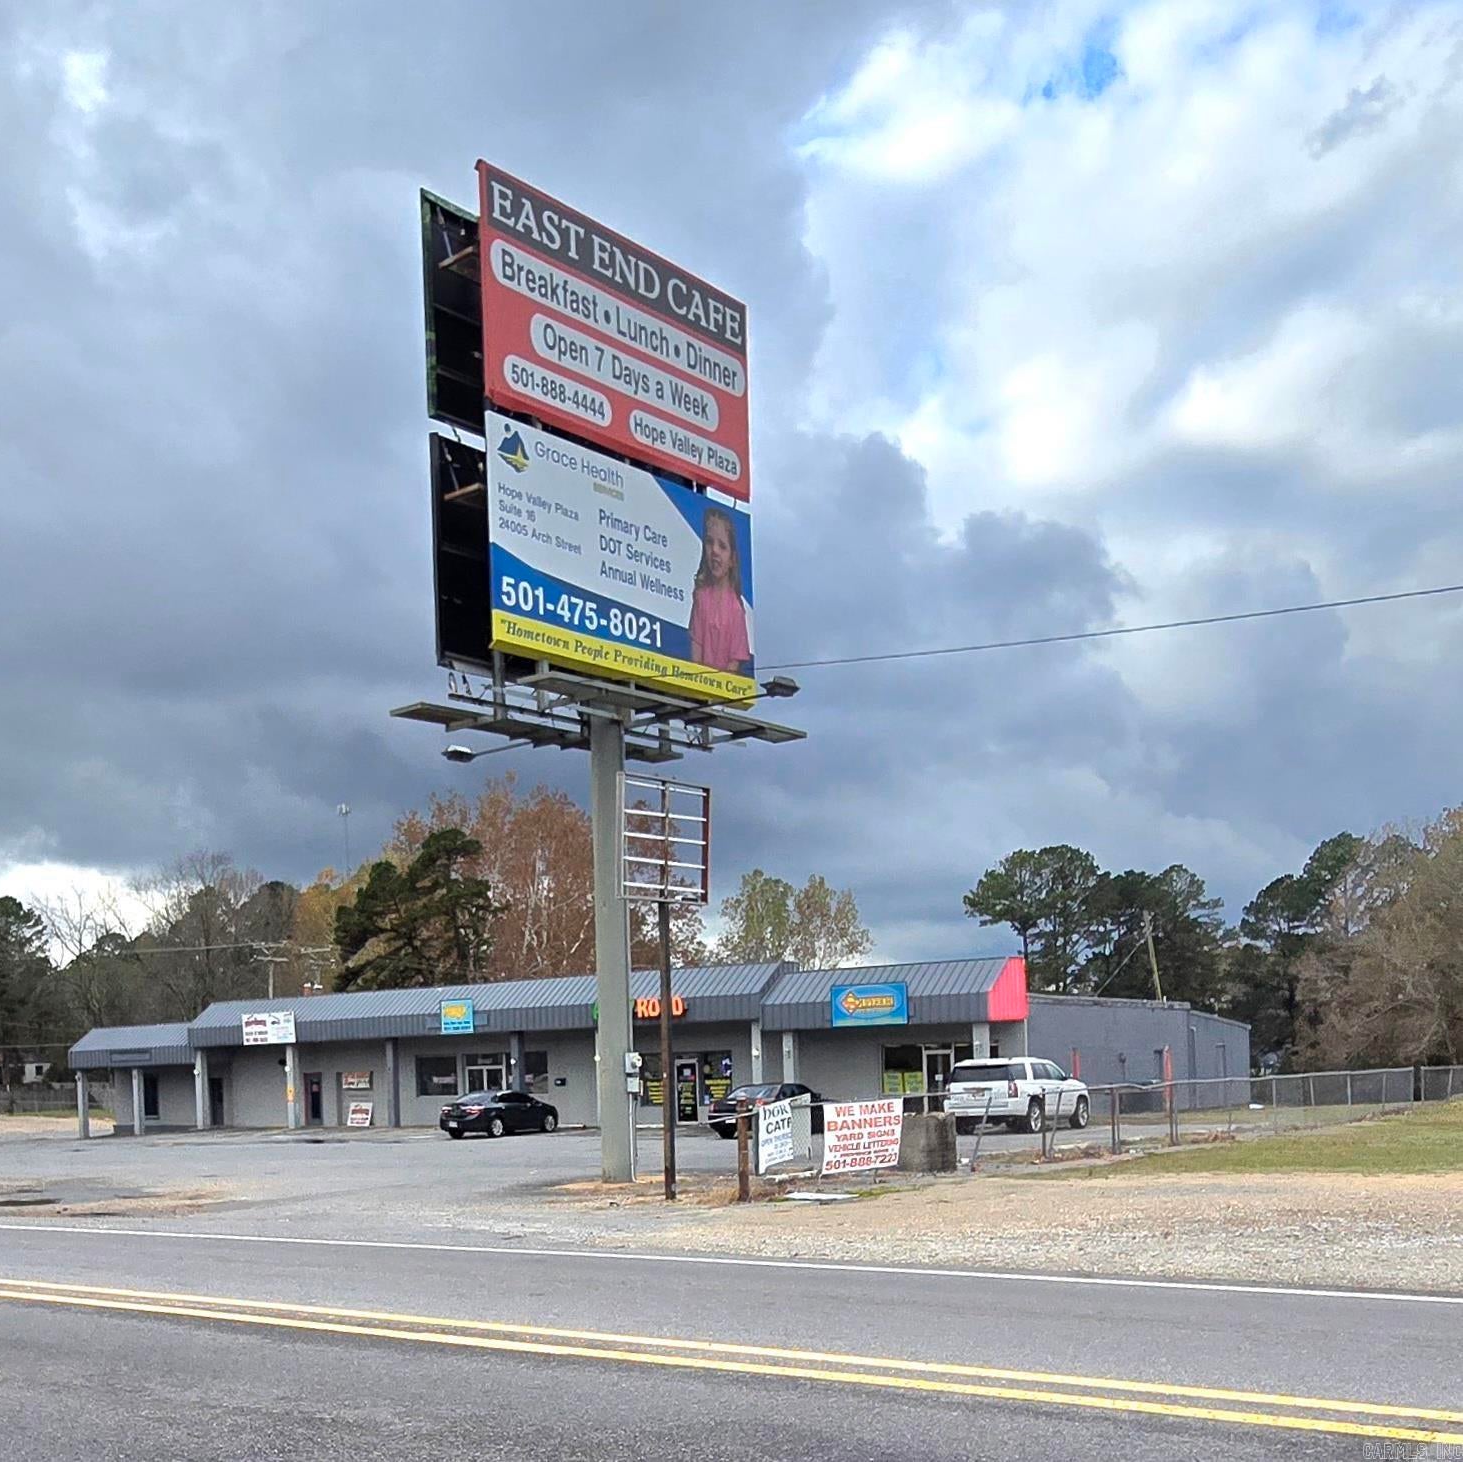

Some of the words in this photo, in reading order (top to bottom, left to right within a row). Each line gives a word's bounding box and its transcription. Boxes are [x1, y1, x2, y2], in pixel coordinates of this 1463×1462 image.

[490, 181, 585, 260] EAST
[591, 234, 661, 300] END
[666, 279, 743, 345] CAFE
[501, 248, 599, 324] Breakfast
[616, 305, 670, 358] Lunch
[686, 341, 738, 391] Dinner
[511, 363, 606, 421] 501-888-4444
[543, 323, 589, 367] Open
[595, 348, 605, 372] 7
[612, 355, 650, 395] Days
[655, 381, 665, 400] a
[669, 379, 709, 421] Week
[535, 441, 578, 470] Grace
[581, 458, 624, 488] Health
[634, 415, 667, 446] Hope
[669, 429, 704, 464] Valley
[707, 446, 738, 474] Plaza
[498, 482, 523, 501] Hope
[526, 491, 552, 514] Valley
[555, 502, 580, 521] Plaza
[498, 500, 523, 517] Suite
[499, 517, 529, 537] 24005
[531, 528, 553, 545] Arch
[555, 535, 583, 555] Street
[599, 508, 641, 541] Primary
[643, 525, 668, 548] Care
[599, 534, 623, 556] DOT
[626, 543, 672, 574] Services
[600, 560, 637, 587] Annual
[640, 572, 685, 602] Wellness
[501, 576, 662, 648] 501-475-8021
[574, 640, 610, 661] People
[614, 651, 668, 676] Providing
[637, 996, 683, 1018] ROD
[827, 1115, 901, 1132] BANNERS
[835, 1105, 855, 1117] WE
[859, 1102, 895, 1115] MAKE
[828, 1142, 861, 1153] VEHICLE
[863, 1138, 899, 1150] LETTERING
[835, 1132, 864, 1142] YARD
[867, 1129, 895, 1139] SIGNS
